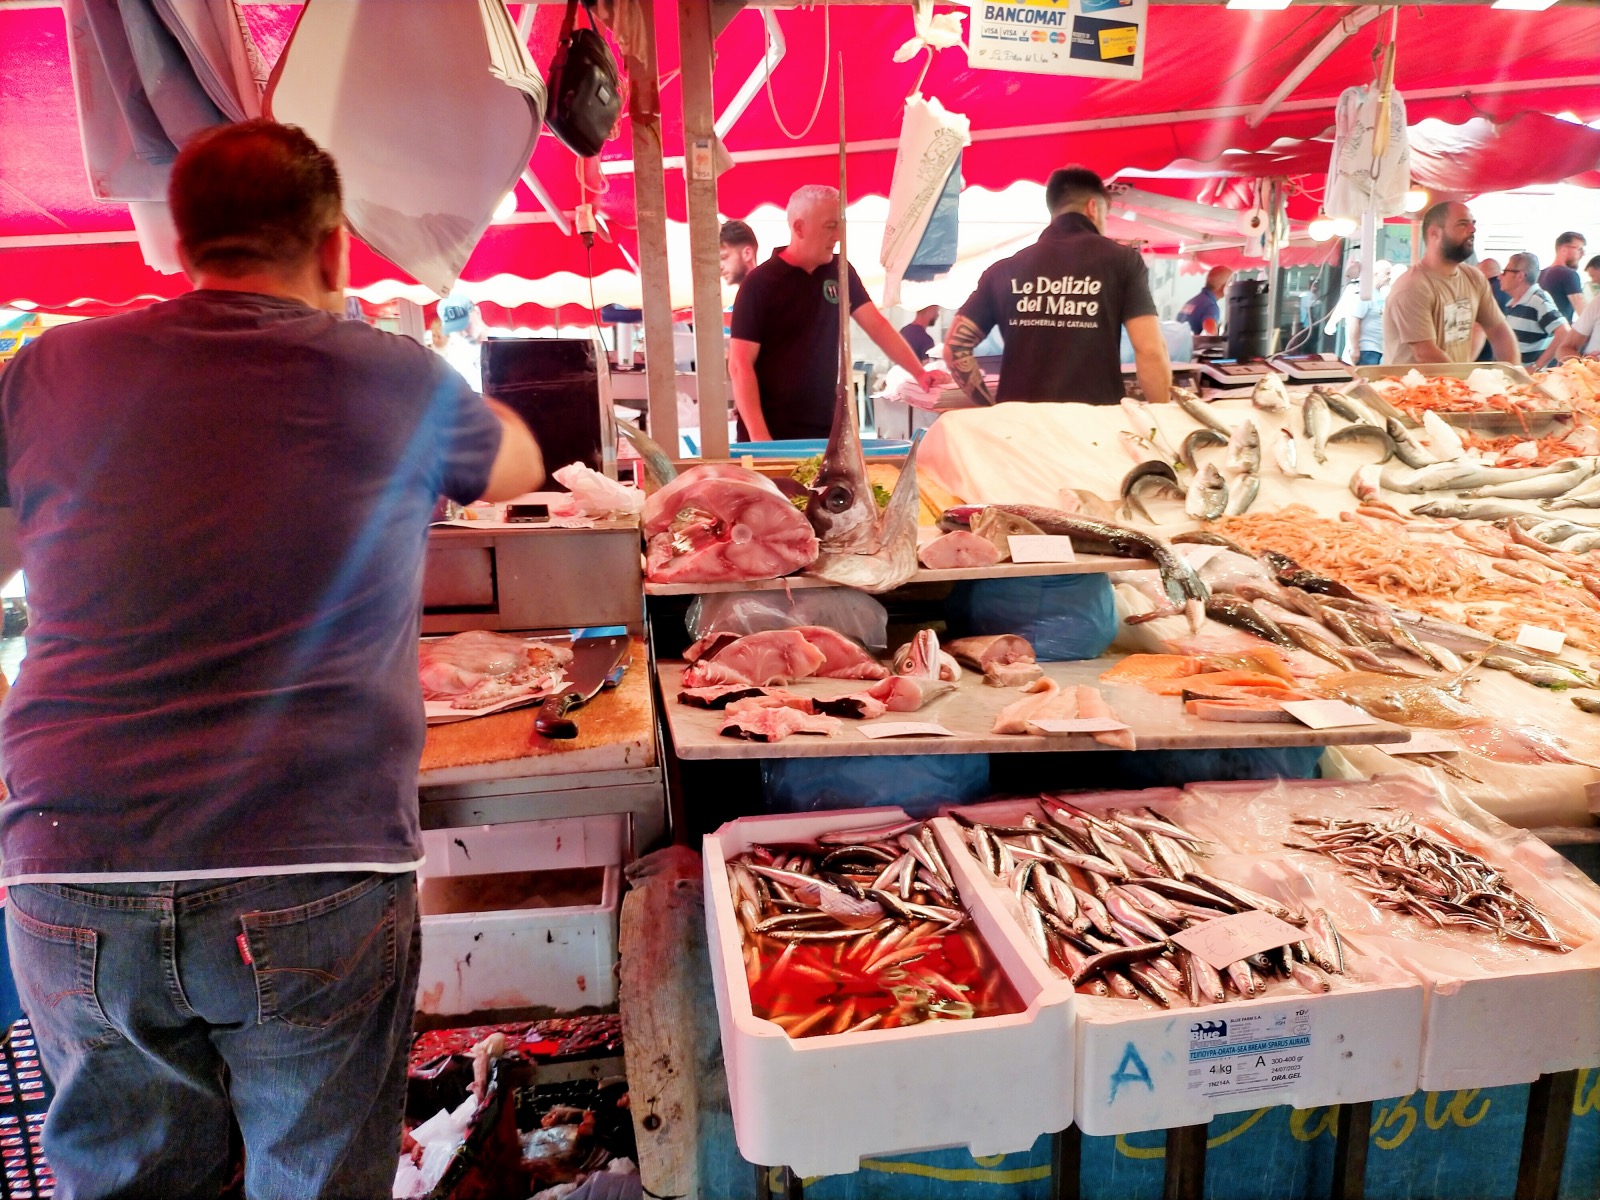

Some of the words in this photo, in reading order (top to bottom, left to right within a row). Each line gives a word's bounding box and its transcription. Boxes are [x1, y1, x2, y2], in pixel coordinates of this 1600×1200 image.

[984, 5, 1066, 26] BANCOMAT
[1011, 278, 1034, 294] Le
[1036, 276, 1102, 295] Delizie
[1016, 296, 1042, 312] del
[1045, 296, 1099, 316] Mare
[1019, 319, 1055, 327] PESCHERIA
[1192, 1029, 1221, 1041] Blue
[1289, 1036, 1310, 1046] AURATA
[1255, 1055, 1266, 1068] A
[1271, 1056, 1296, 1065] 300-400
[1106, 1041, 1154, 1106] A
[1209, 1065, 1216, 1075] 4
[1220, 1064, 1232, 1075] kg
[1271, 1064, 1301, 1073] 24/07/2023
